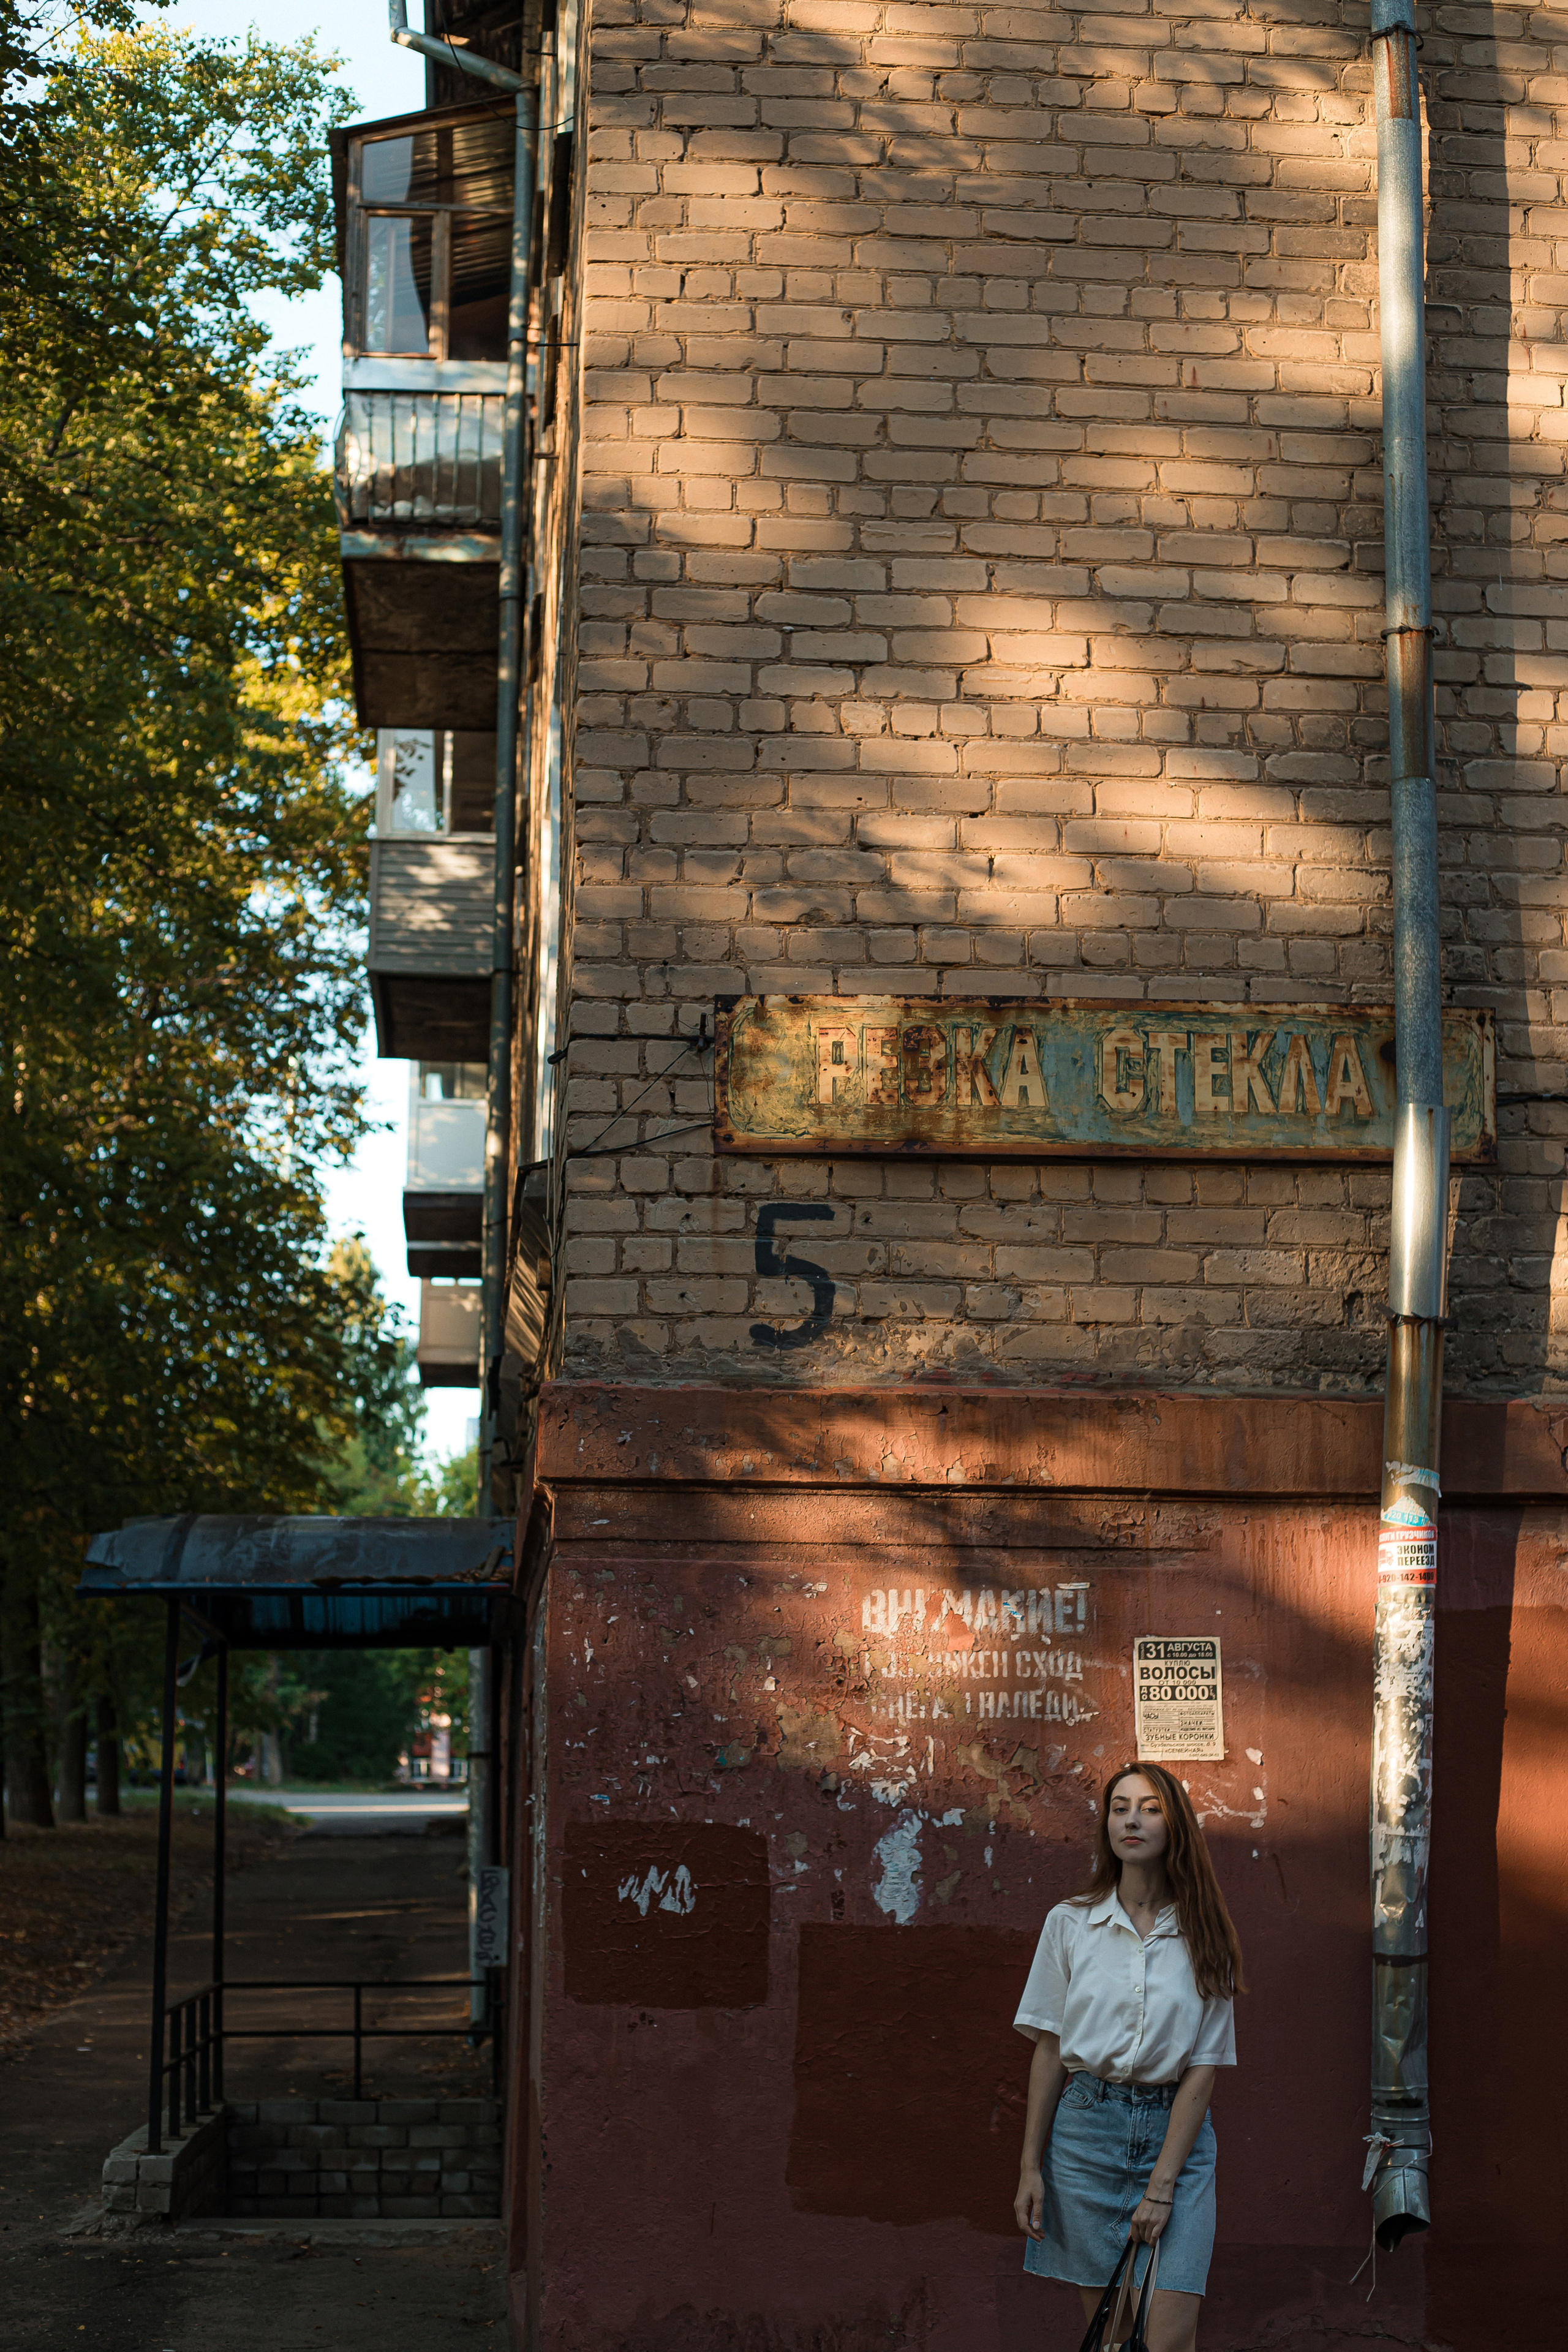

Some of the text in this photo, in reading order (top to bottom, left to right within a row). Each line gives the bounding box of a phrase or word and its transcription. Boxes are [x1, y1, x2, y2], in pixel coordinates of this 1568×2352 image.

[818, 1026, 1373, 1115] РЕЗКА СТЕКЛА
[748, 1202, 836, 1350] 5
[1396, 1544, 1434, 1555] ЭКОНОМ
[1397, 1555, 1435, 1567] ПЕРЕЕЗД
[1146, 1643, 1213, 1659] 31 АВГУСТА
[1015, 1649, 1084, 1681] СХОД
[1140, 1666, 1215, 1680] ВОЛОСЫ
[1140, 1687, 1148, 1700] ДО
[1149, 1686, 1172, 1700] 80
[1175, 1686, 1209, 1700] 000
